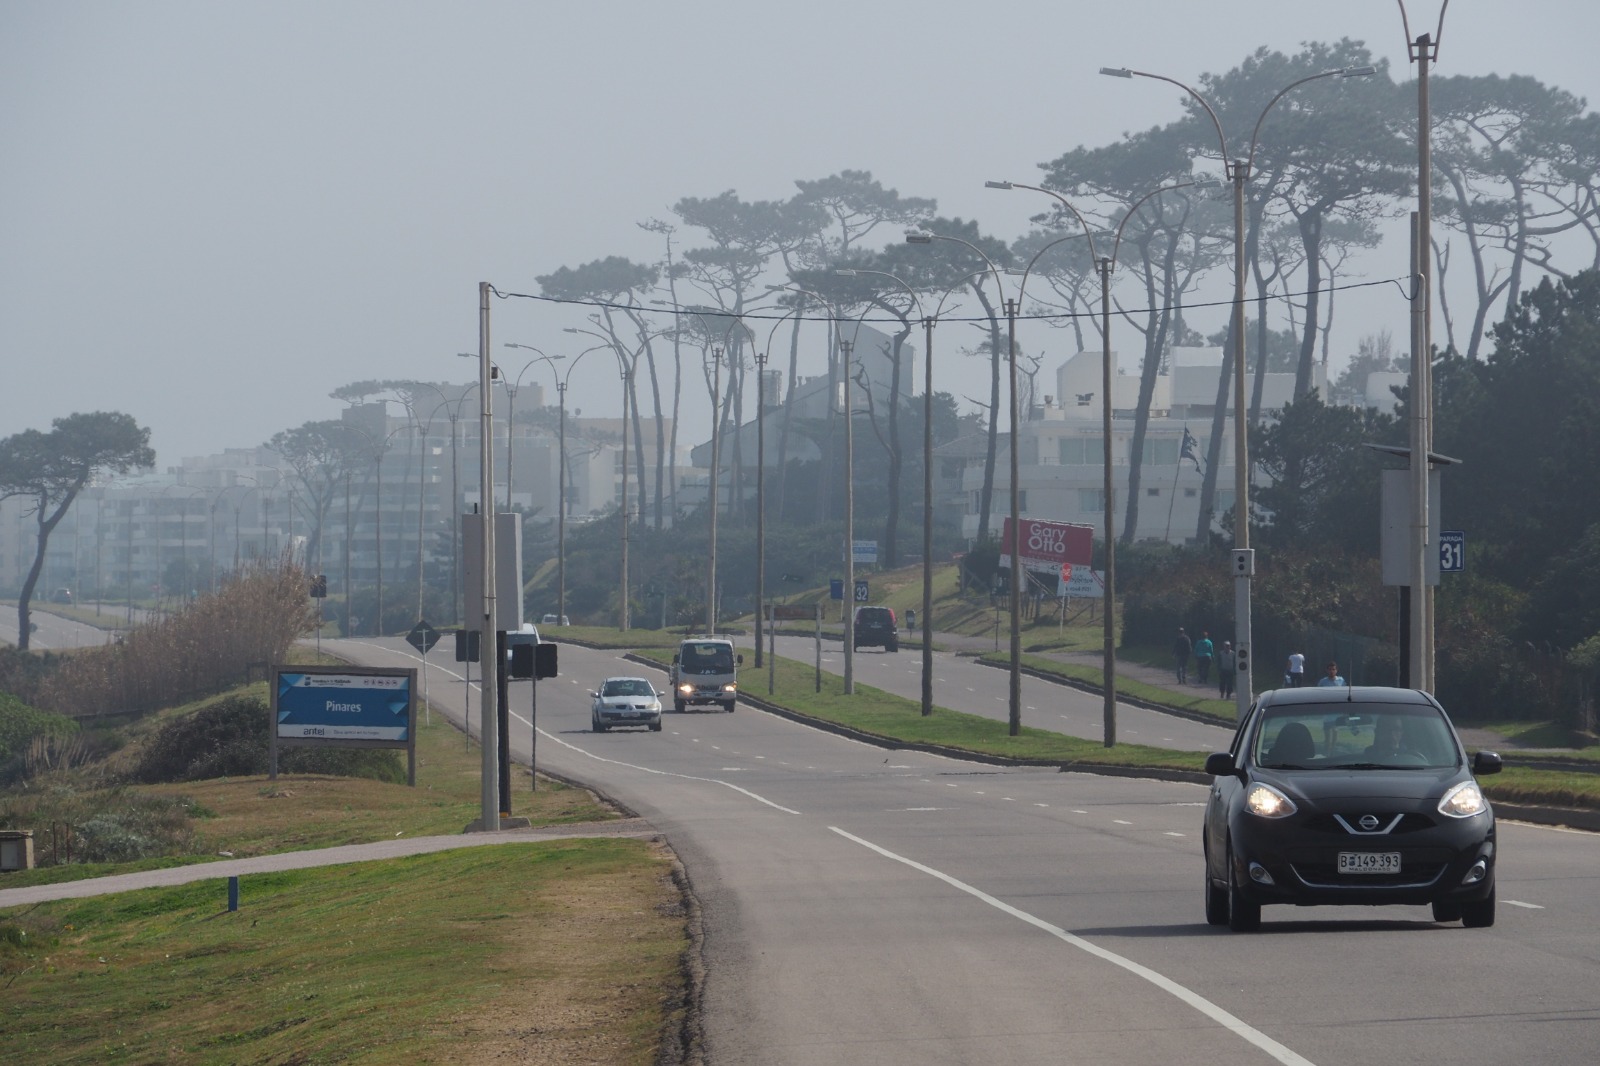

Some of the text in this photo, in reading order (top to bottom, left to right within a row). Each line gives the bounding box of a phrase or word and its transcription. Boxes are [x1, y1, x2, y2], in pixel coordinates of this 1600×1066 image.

[1030, 523, 1066, 541] Gary
[1028, 536, 1066, 553] Otto
[1441, 543, 1461, 569] 31
[856, 586, 868, 601] 32
[326, 700, 362, 713] Pinares
[303, 727, 325, 736] antel
